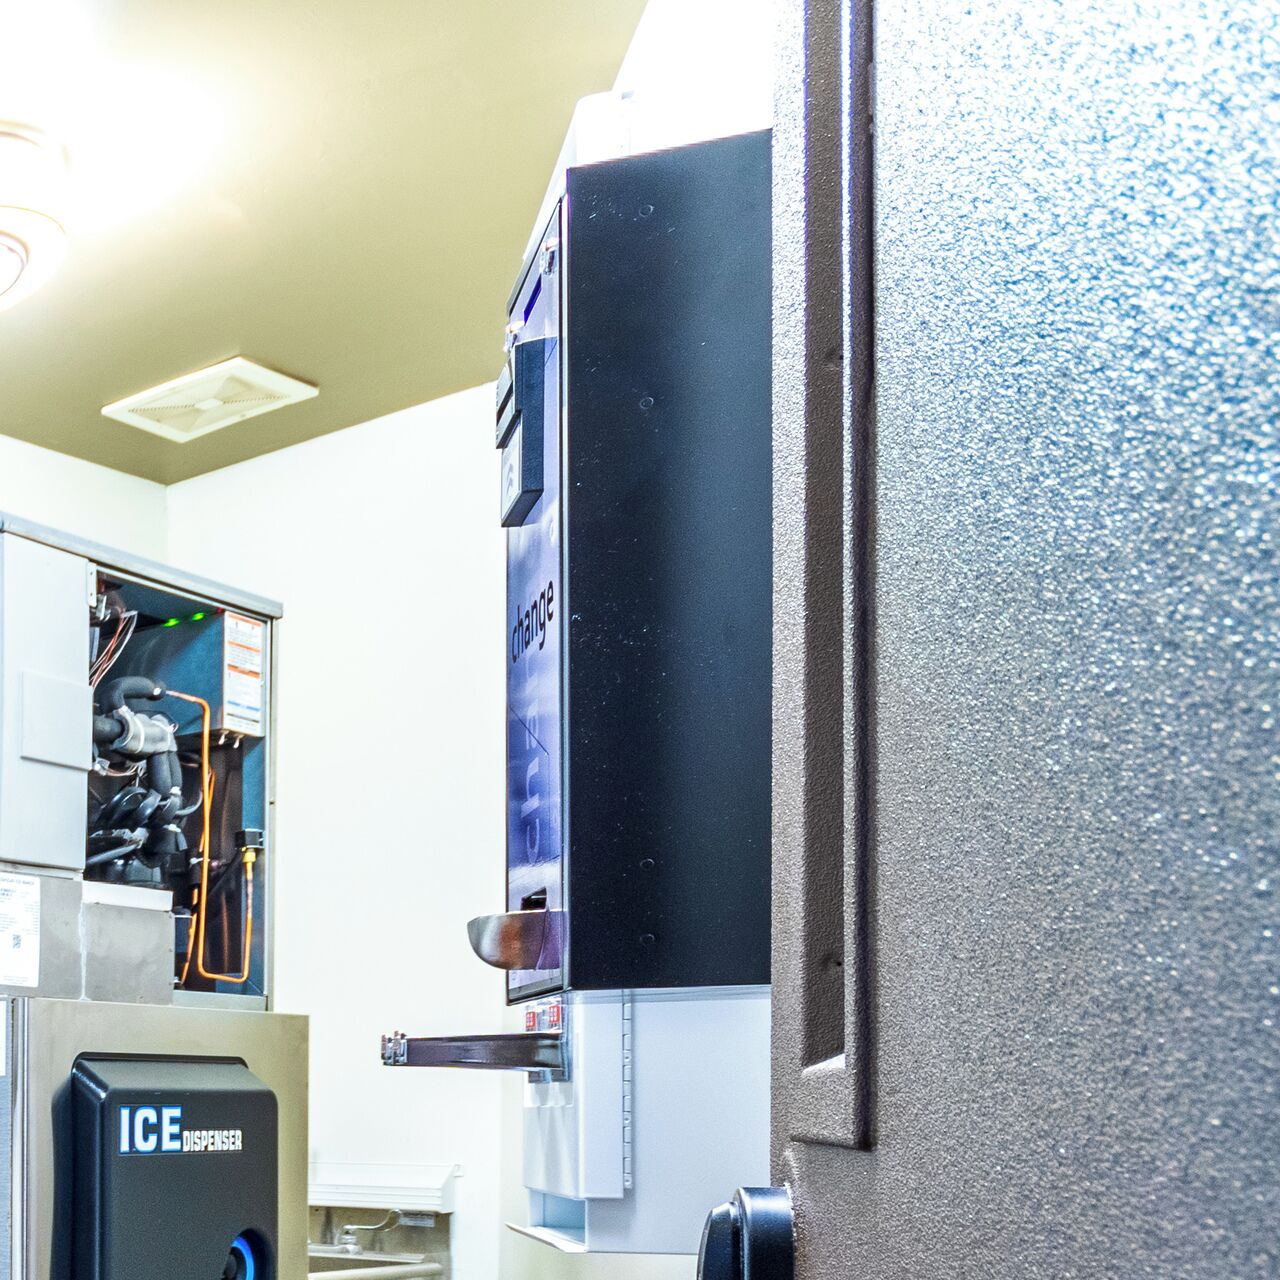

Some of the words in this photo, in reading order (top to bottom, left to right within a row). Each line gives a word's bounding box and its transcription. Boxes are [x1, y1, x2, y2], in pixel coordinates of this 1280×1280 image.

[512, 580, 554, 664] change
[120, 1106, 182, 1153] ICE
[182, 1129, 243, 1153] DISPENSER
